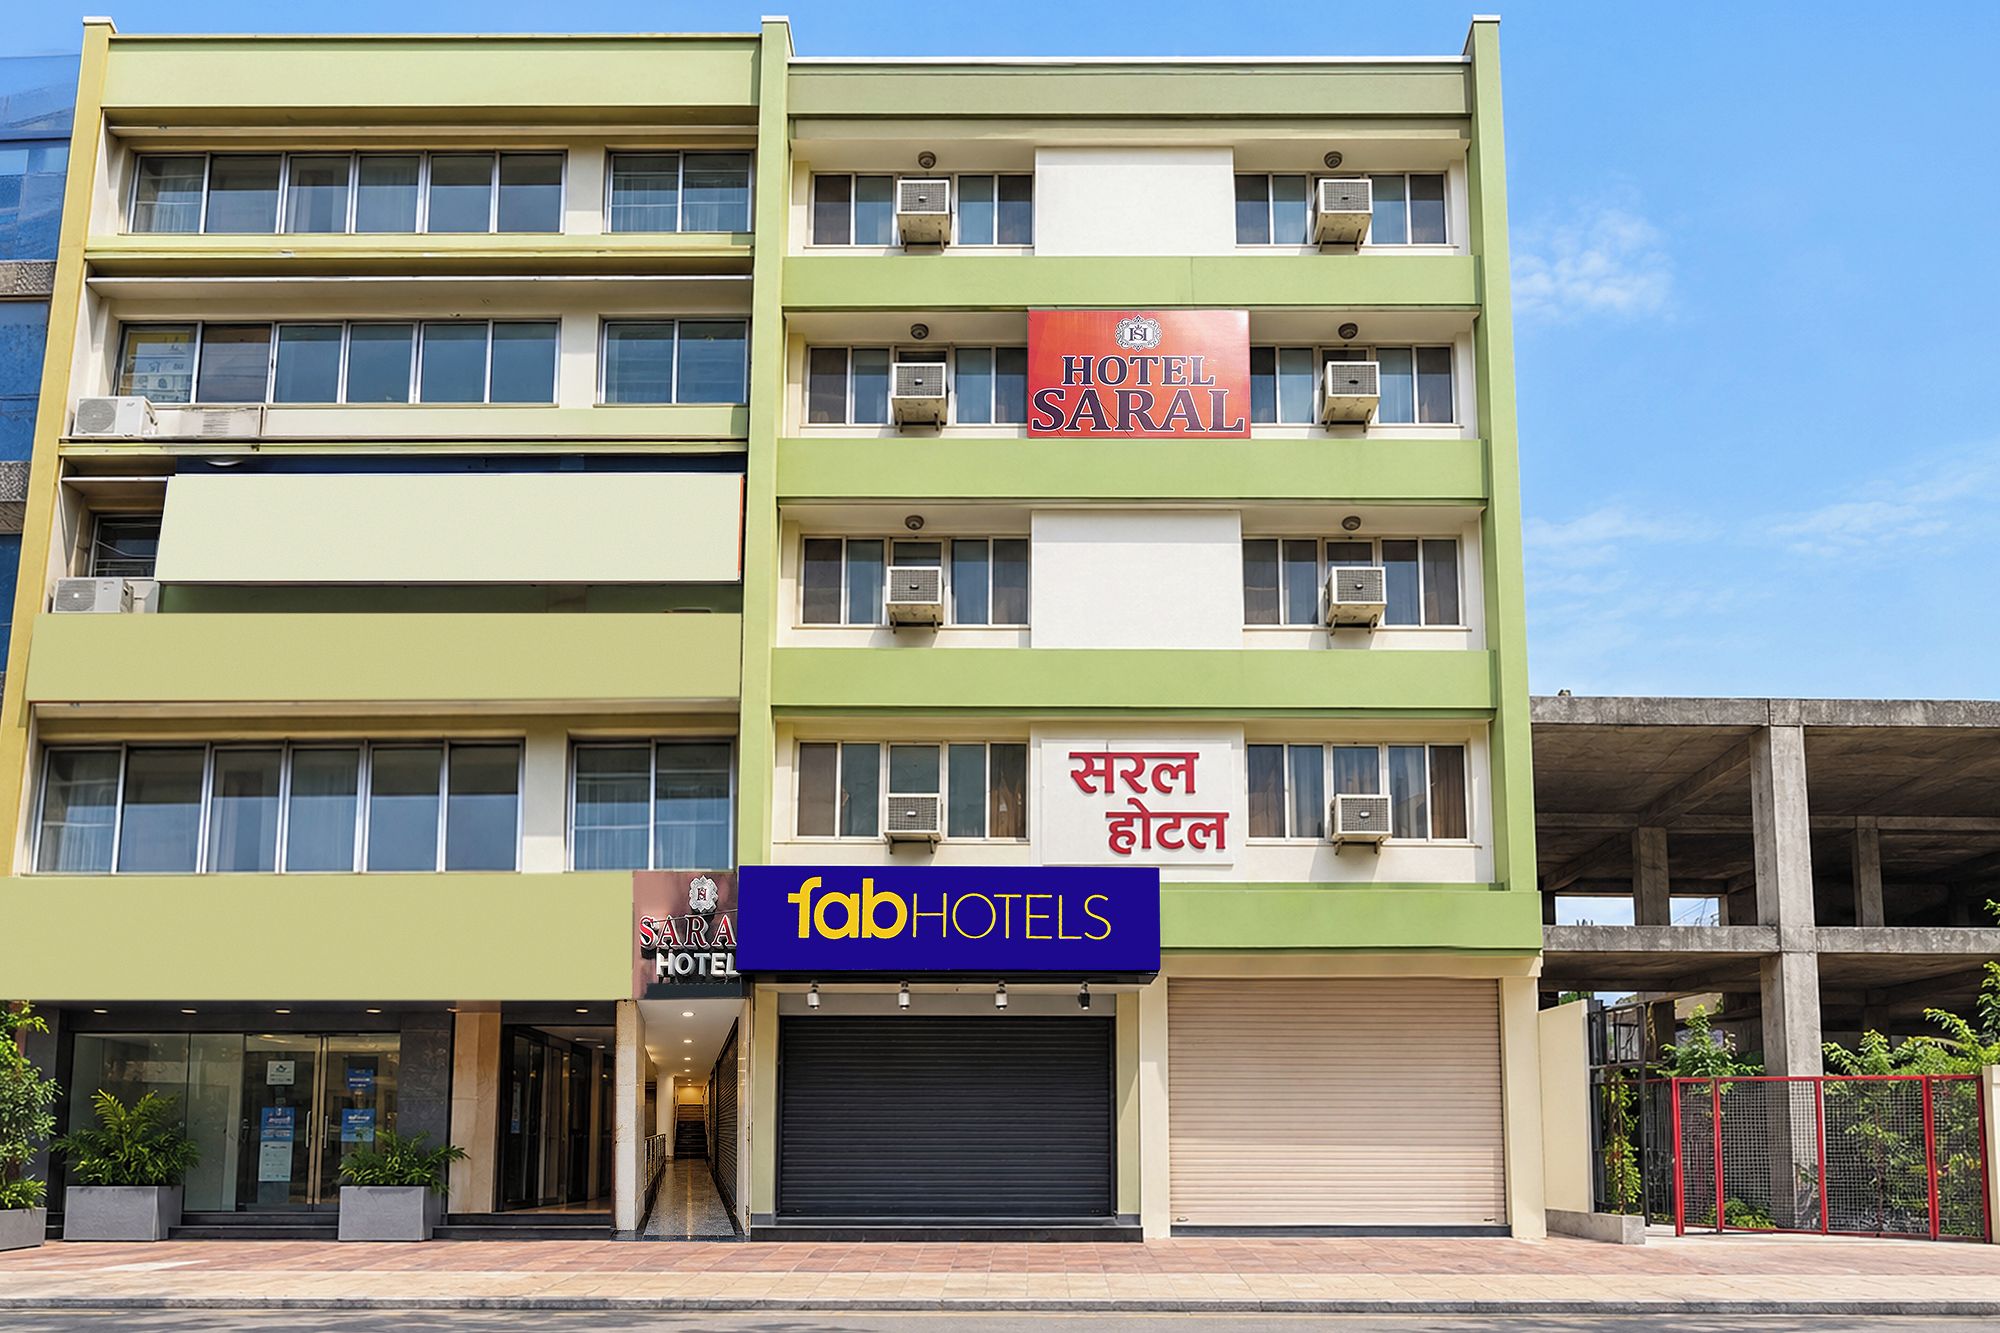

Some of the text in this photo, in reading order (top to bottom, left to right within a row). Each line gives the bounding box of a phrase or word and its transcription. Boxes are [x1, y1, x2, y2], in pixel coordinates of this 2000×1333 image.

[1062, 355, 1216, 386] HOTEL
[1031, 388, 1245, 433] SARAL
[1069, 752, 1199, 794] सरल
[1105, 797, 1230, 855] होटल
[639, 914, 737, 949] SARA
[656, 952, 741, 977] HOTEL
